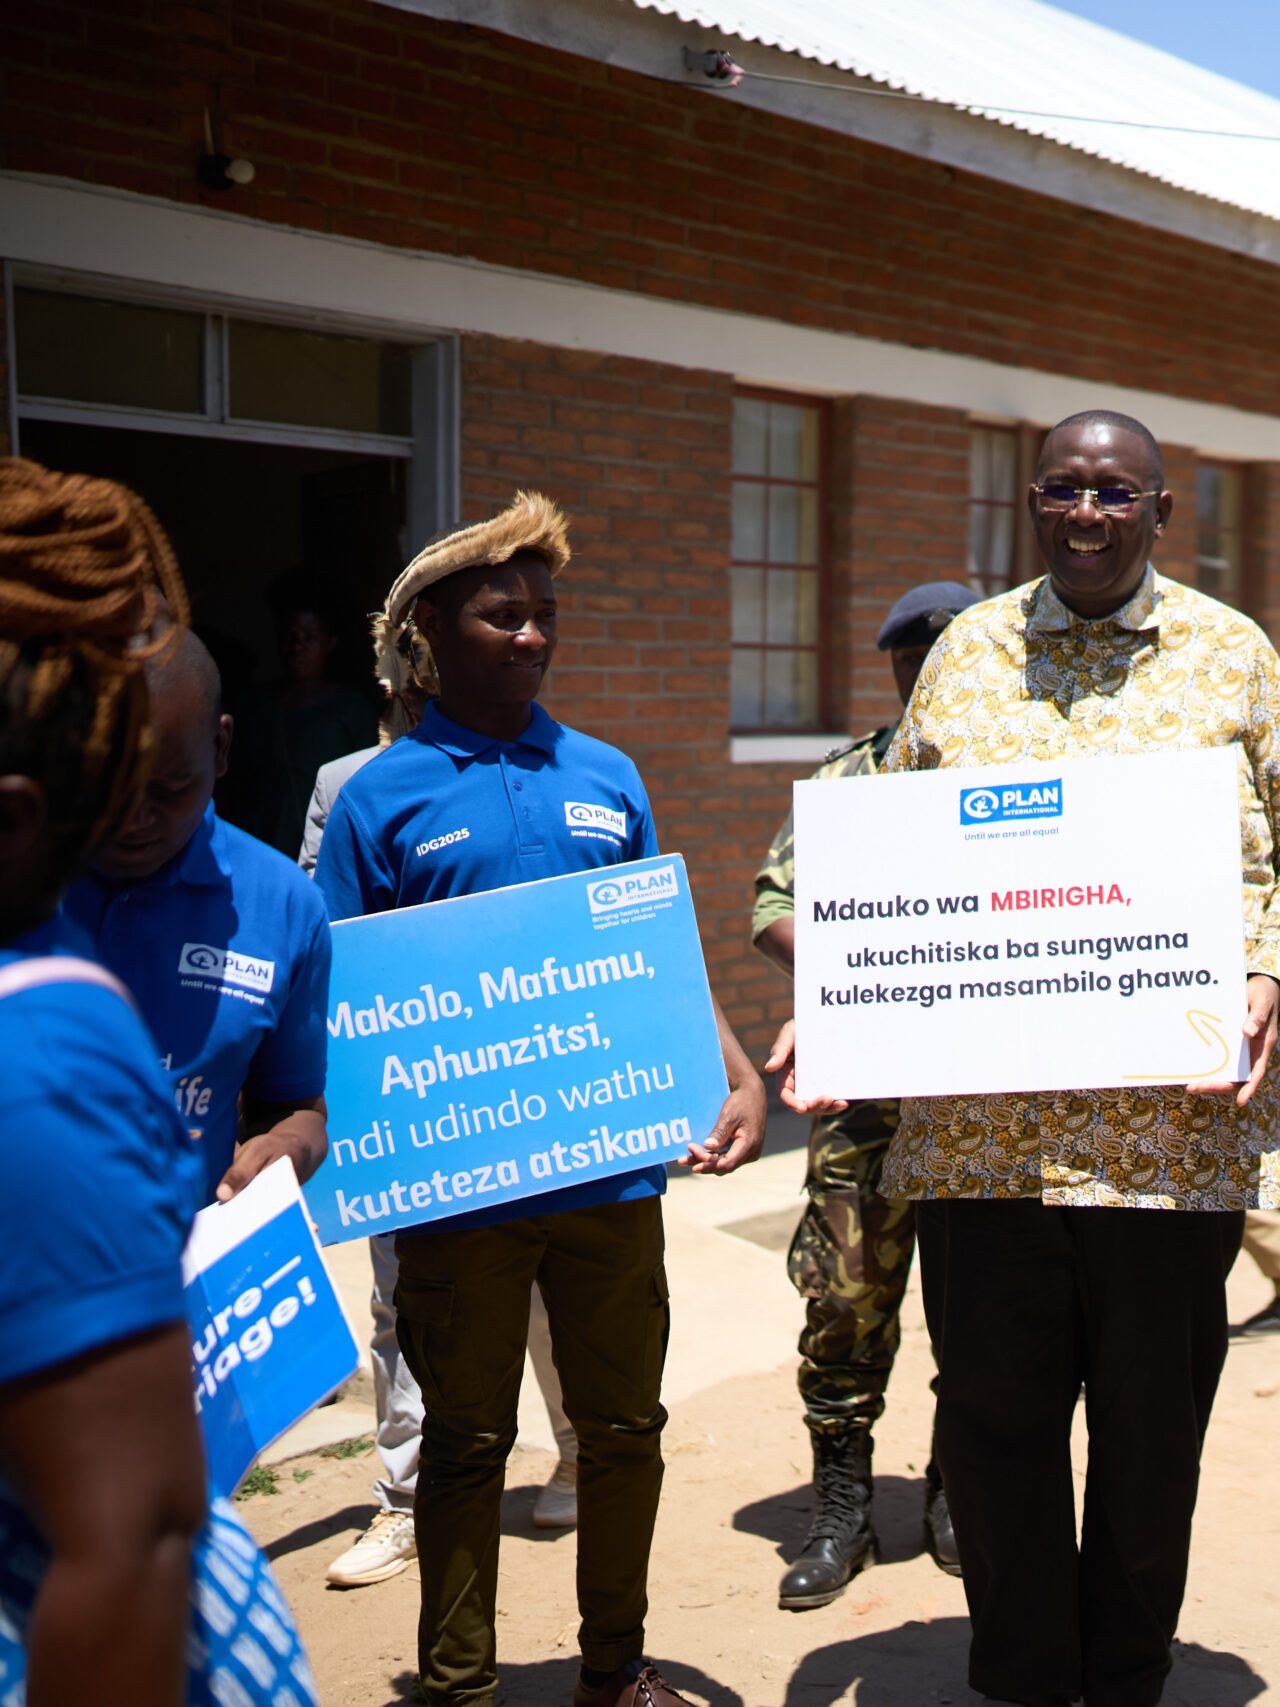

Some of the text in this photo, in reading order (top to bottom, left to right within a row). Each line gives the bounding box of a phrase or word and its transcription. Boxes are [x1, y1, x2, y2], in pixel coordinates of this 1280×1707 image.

[1002, 787, 1059, 808] PLAN
[1003, 806, 1059, 816] INTERNATIONAL
[595, 810, 623, 828] PLAN
[964, 827, 1059, 841] Until we are all equal
[416, 827, 470, 857] IDG2025
[624, 873, 673, 893] PLAN
[592, 912, 619, 923] Bringing
[813, 884, 1132, 923] Mdauko wa MBIRIGHA,
[223, 956, 269, 979] PLAN
[846, 930, 1189, 969] ukuchitiska ba sungwana
[327, 950, 655, 1039] Makolo, Mafumu,
[820, 967, 1219, 1013] kulekezga masambilo ghawo.
[381, 1012, 611, 1099] Aphunzitsi,
[175, 1076, 213, 1117] ife
[332, 1061, 675, 1167] ndi udindo wathu
[336, 1117, 692, 1226] kuteteza atsikana
[194, 1276, 317, 1415] riage!
